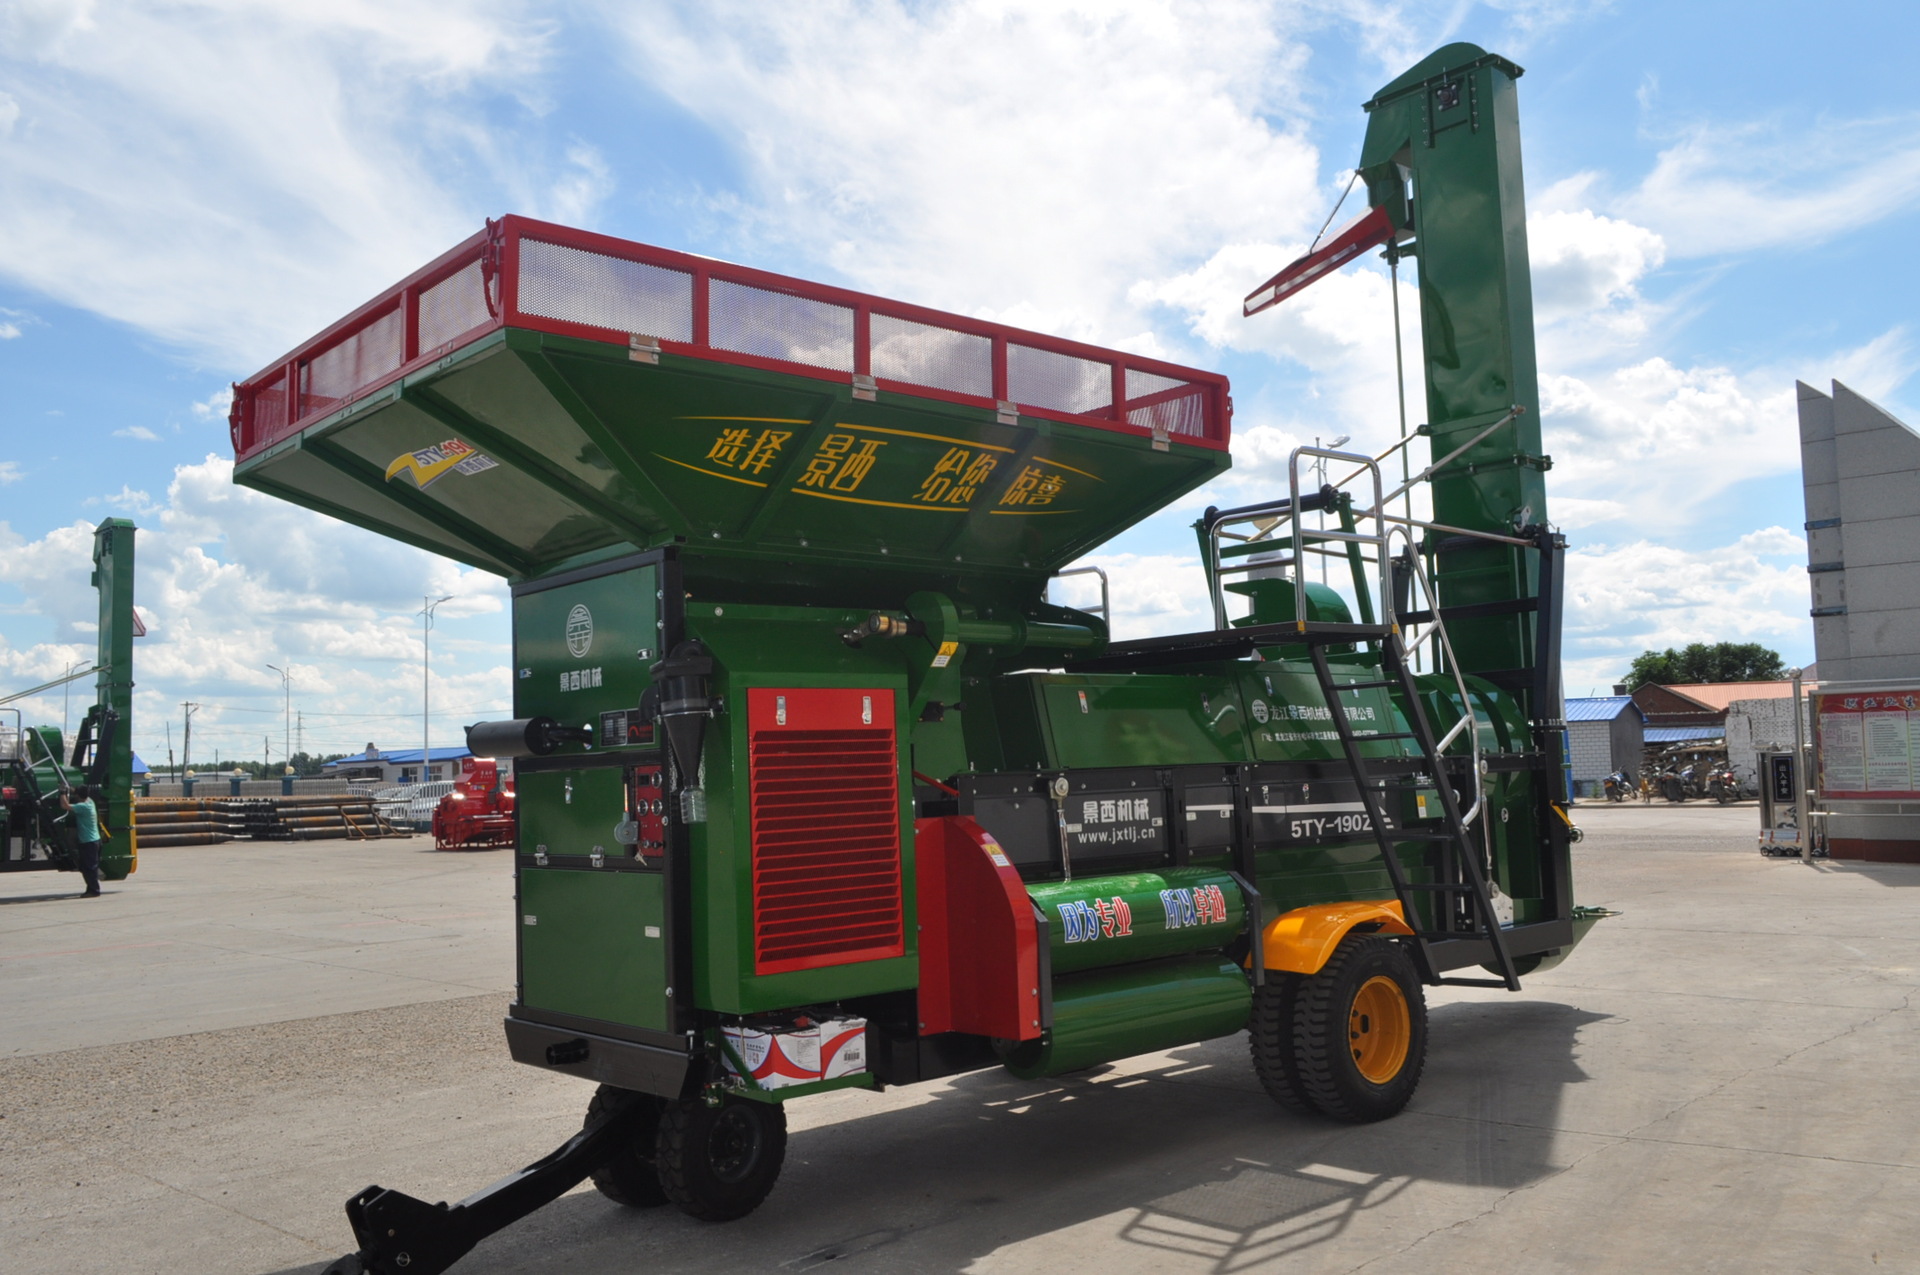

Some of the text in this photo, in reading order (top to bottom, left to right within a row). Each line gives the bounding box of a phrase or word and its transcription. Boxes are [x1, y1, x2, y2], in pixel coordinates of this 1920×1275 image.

[704, 427, 1067, 506] 选择 景西 给您 惊喜
[560, 666, 602, 692] 景西机械
[1270, 704, 1375, 721] 龙江景西机械制有限公司
[1083, 798, 1150, 824] 景西机械
[1077, 826, 1156, 844] www.jxtlj.cn
[1057, 884, 1227, 943] 因为专业 所以卓越
